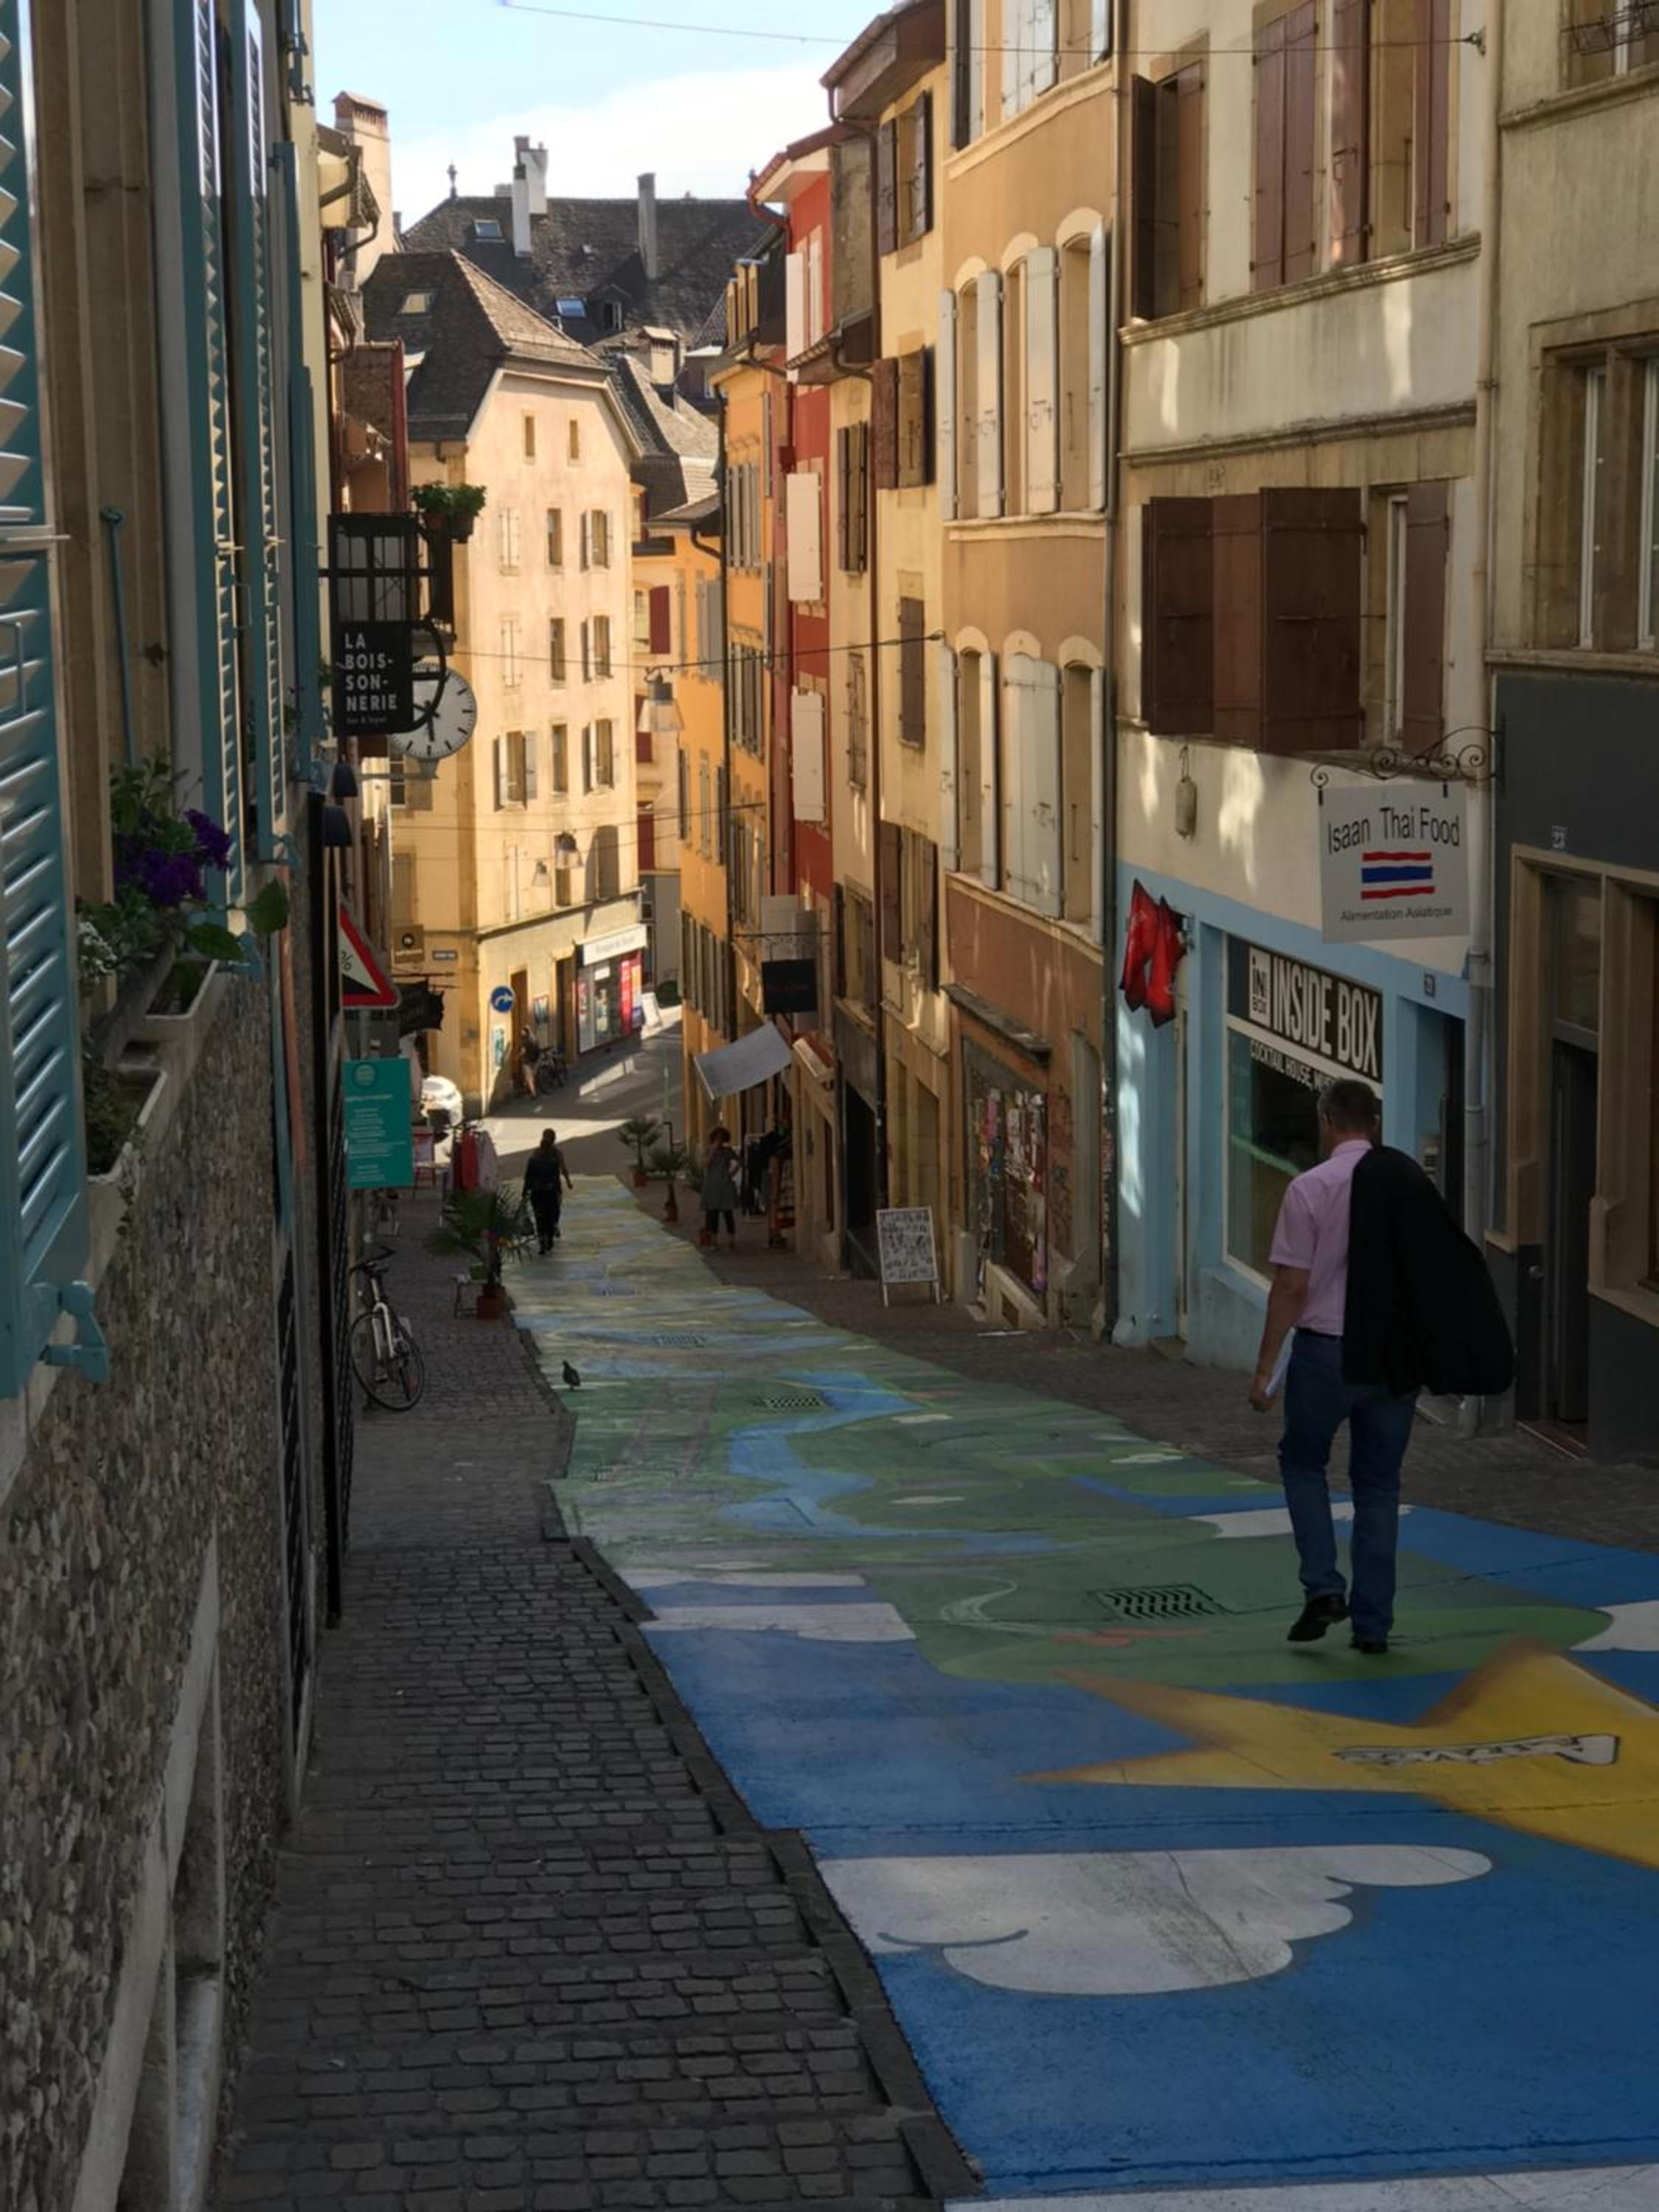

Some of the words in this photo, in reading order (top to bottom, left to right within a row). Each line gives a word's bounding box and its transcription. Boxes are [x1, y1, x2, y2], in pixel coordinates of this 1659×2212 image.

[344, 633, 366, 649] LA
[344, 652, 394, 670] BOIS-
[345, 674, 389, 691] SON-
[346, 694, 398, 712] NERIE
[1328, 818, 1371, 855] Isaan
[1380, 806, 1416, 840] Thai
[1420, 807, 1461, 847] Food
[1340, 908, 1404, 922] Alimentation
[1405, 906, 1453, 919] Asiatique
[1273, 956, 1333, 1055] INSIDE
[1338, 983, 1379, 1077] BOX
[1251, 1039, 1285, 1074] COCKTAIL
